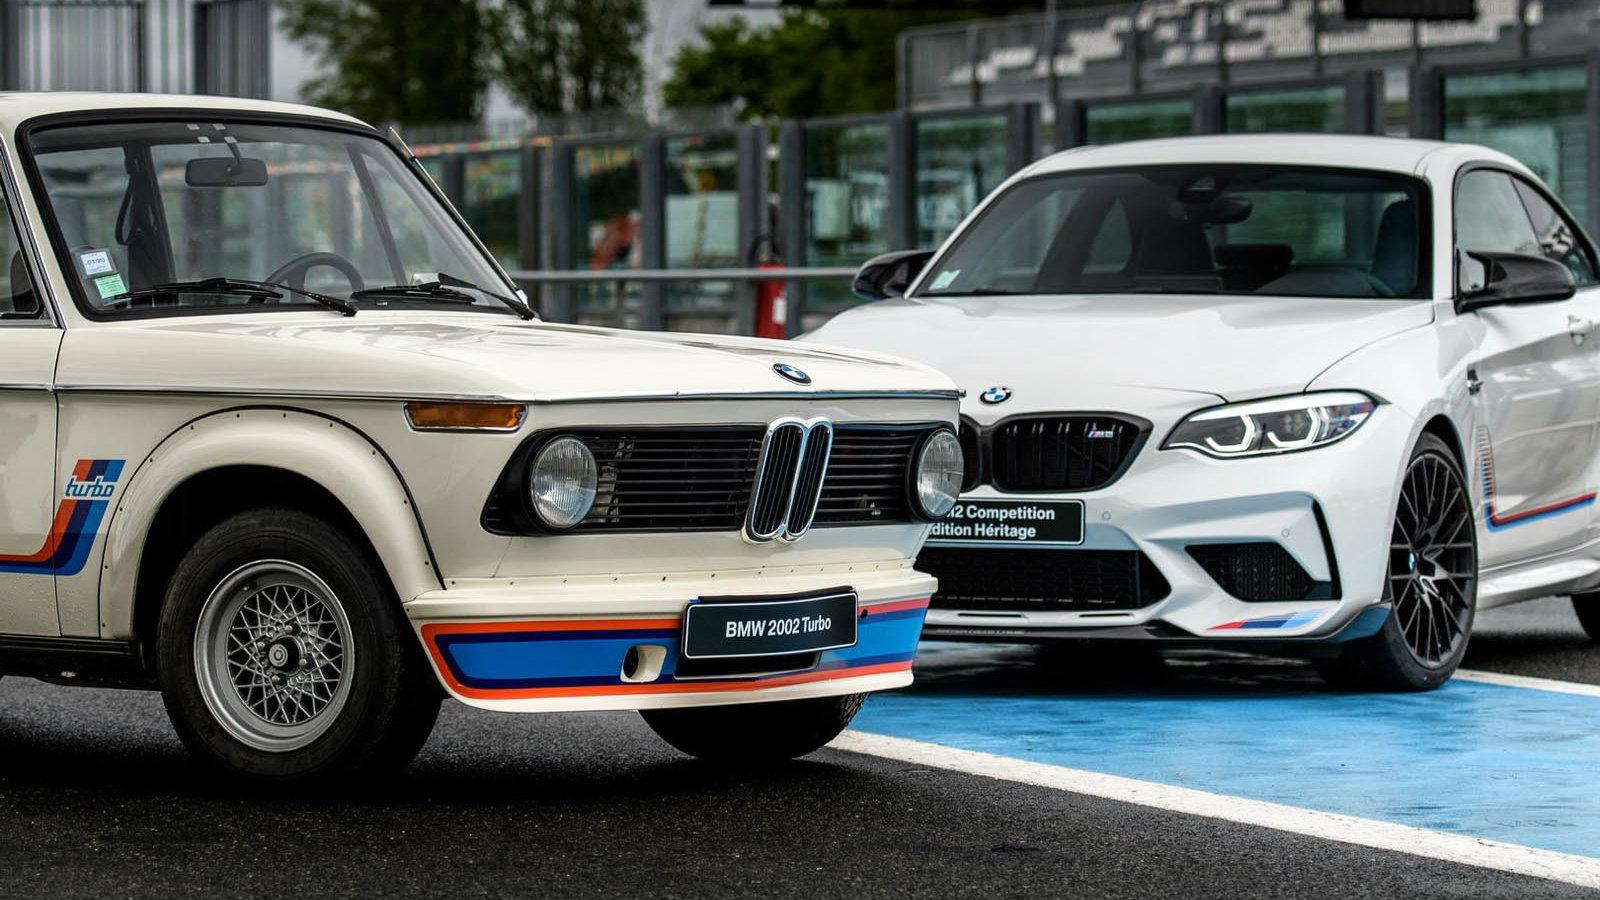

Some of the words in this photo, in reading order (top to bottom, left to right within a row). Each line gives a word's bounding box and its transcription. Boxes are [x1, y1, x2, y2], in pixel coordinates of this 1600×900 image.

[65, 477, 115, 497] turbo
[966, 505, 1056, 521] Competition
[931, 523, 971, 537] dition
[974, 523, 1037, 540] Héritage
[725, 621, 766, 638] BMW
[768, 617, 800, 636] 2002
[802, 615, 832, 632] Turbo
